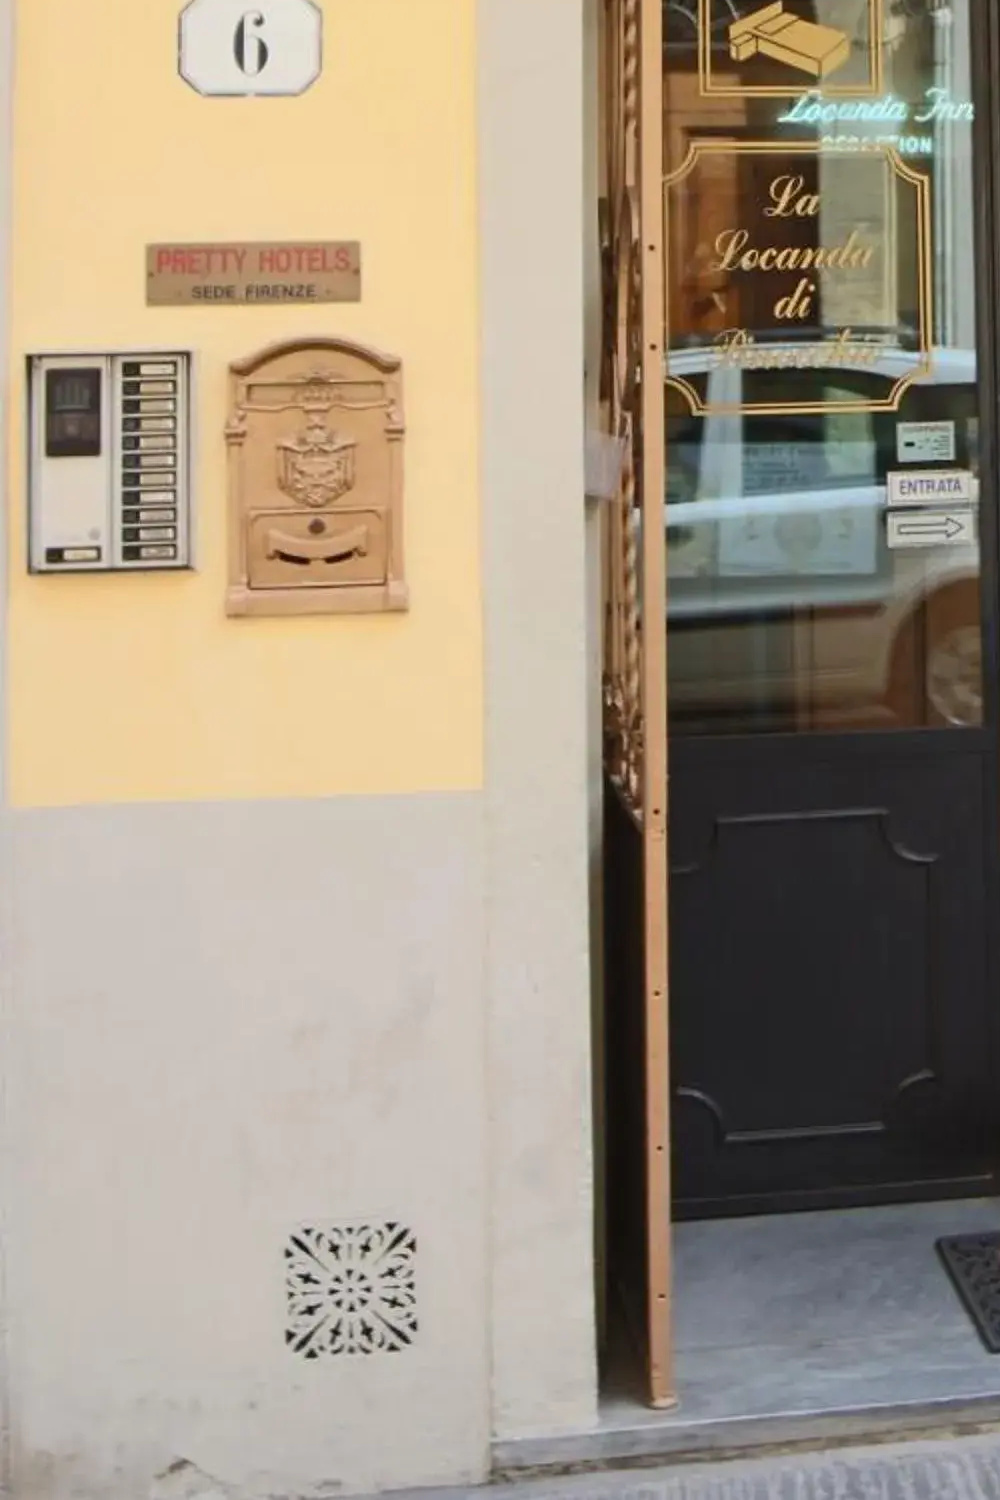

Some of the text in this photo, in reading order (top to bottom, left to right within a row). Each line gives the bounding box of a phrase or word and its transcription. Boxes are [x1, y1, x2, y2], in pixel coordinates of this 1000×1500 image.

[233, 10, 269, 77] 6
[914, 87, 975, 122] Inn
[762, 175, 820, 217] La
[156, 247, 350, 275] PRETTY HOTELS
[711, 229, 874, 271] Locanda
[191, 284, 317, 300] SEDE FIRENZE
[774, 278, 816, 319] di
[900, 478, 962, 496] ENTRATA
